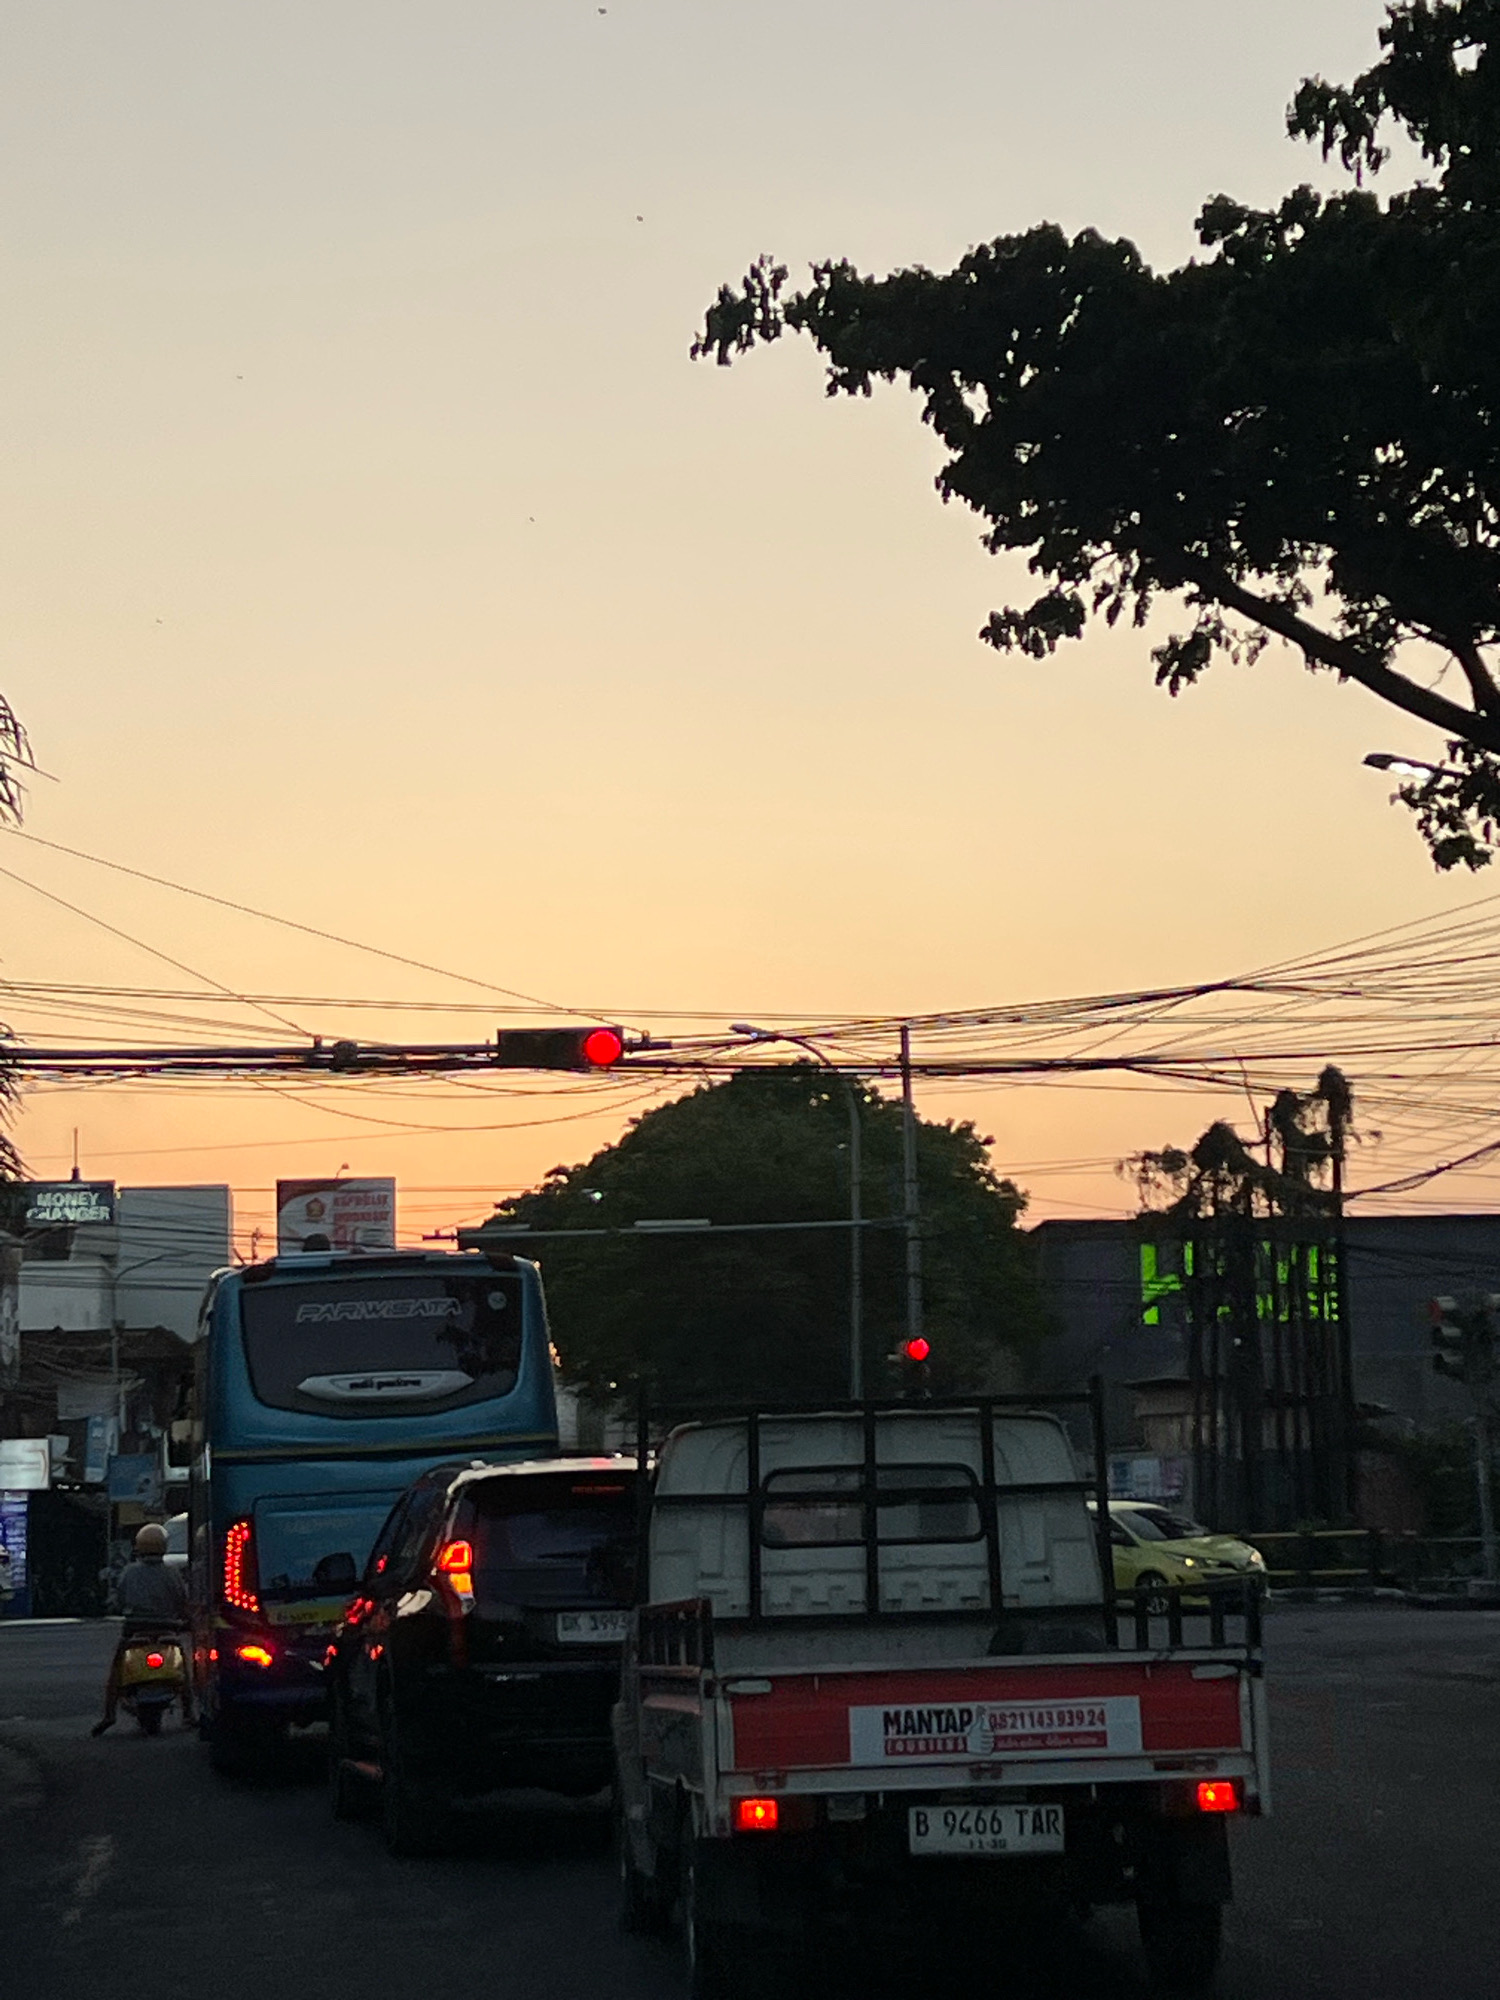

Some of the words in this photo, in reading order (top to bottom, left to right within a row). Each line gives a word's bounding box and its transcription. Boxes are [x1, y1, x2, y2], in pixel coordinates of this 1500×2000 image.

[36, 1191, 100, 1207] MONEY
[295, 1297, 463, 1323] PARIWISATA
[883, 1707, 973, 1736] MANTAP
[915, 1810, 930, 1837] B
[943, 1809, 1003, 1836] 9466
[1015, 1808, 1061, 1836] TAR
